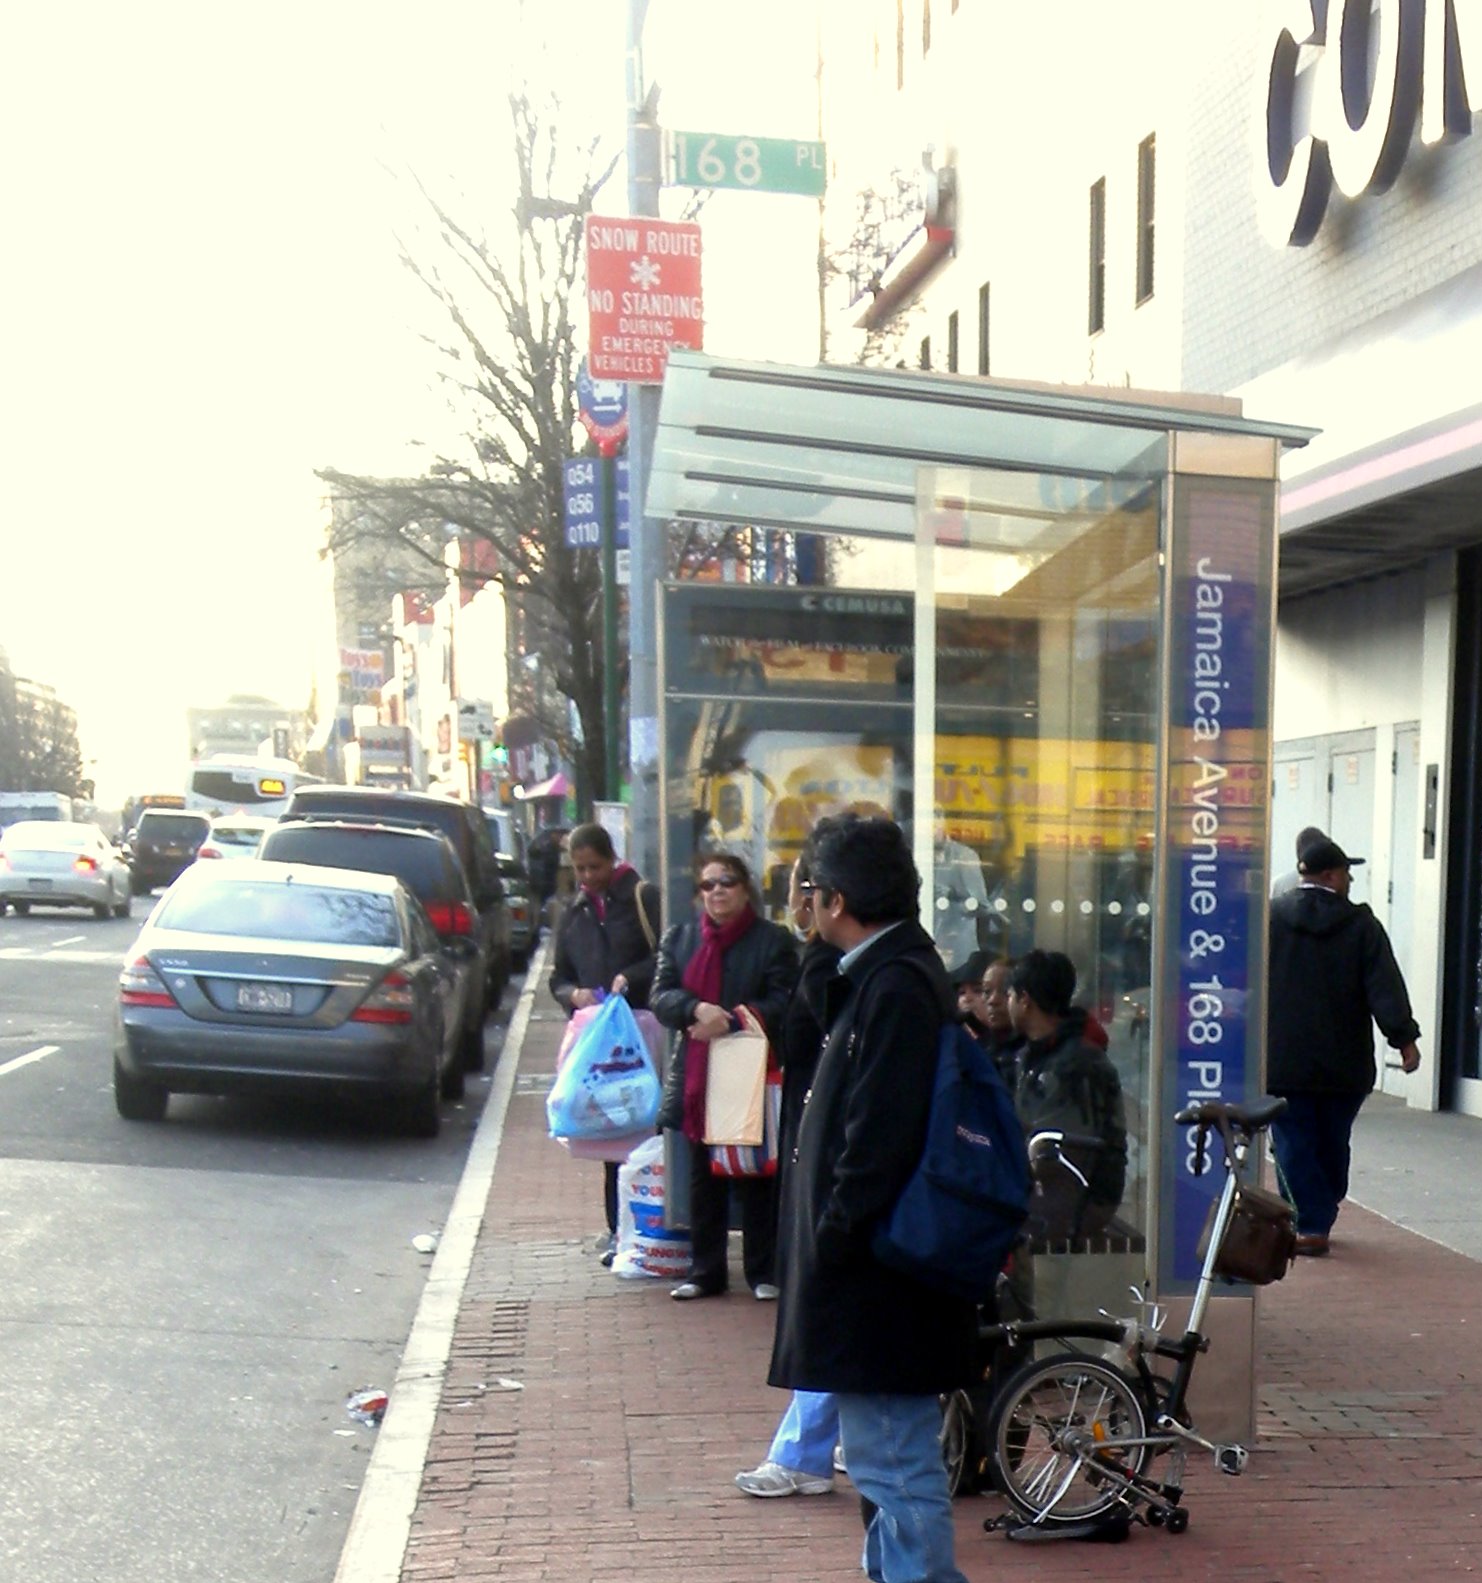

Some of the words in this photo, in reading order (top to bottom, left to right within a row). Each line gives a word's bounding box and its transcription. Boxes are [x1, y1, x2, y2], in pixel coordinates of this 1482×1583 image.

[676, 135, 762, 186] 168
[796, 143, 823, 170] PL
[590, 226, 638, 252] SNOW
[647, 230, 700, 257] ROUTE
[591, 289, 615, 314] NO
[622, 291, 702, 320] STANDING
[619, 317, 674, 337] DURING
[594, 354, 654, 375] VEHICLES
[567, 462, 595, 487] Q54
[568, 492, 594, 516] Q56
[569, 521, 600, 545] Q110
[1193, 557, 1232, 743] Jamaica
[1189, 756, 1228, 916] Avenue
[1189, 928, 1225, 959] &
[1187, 975, 1223, 1045] 168
